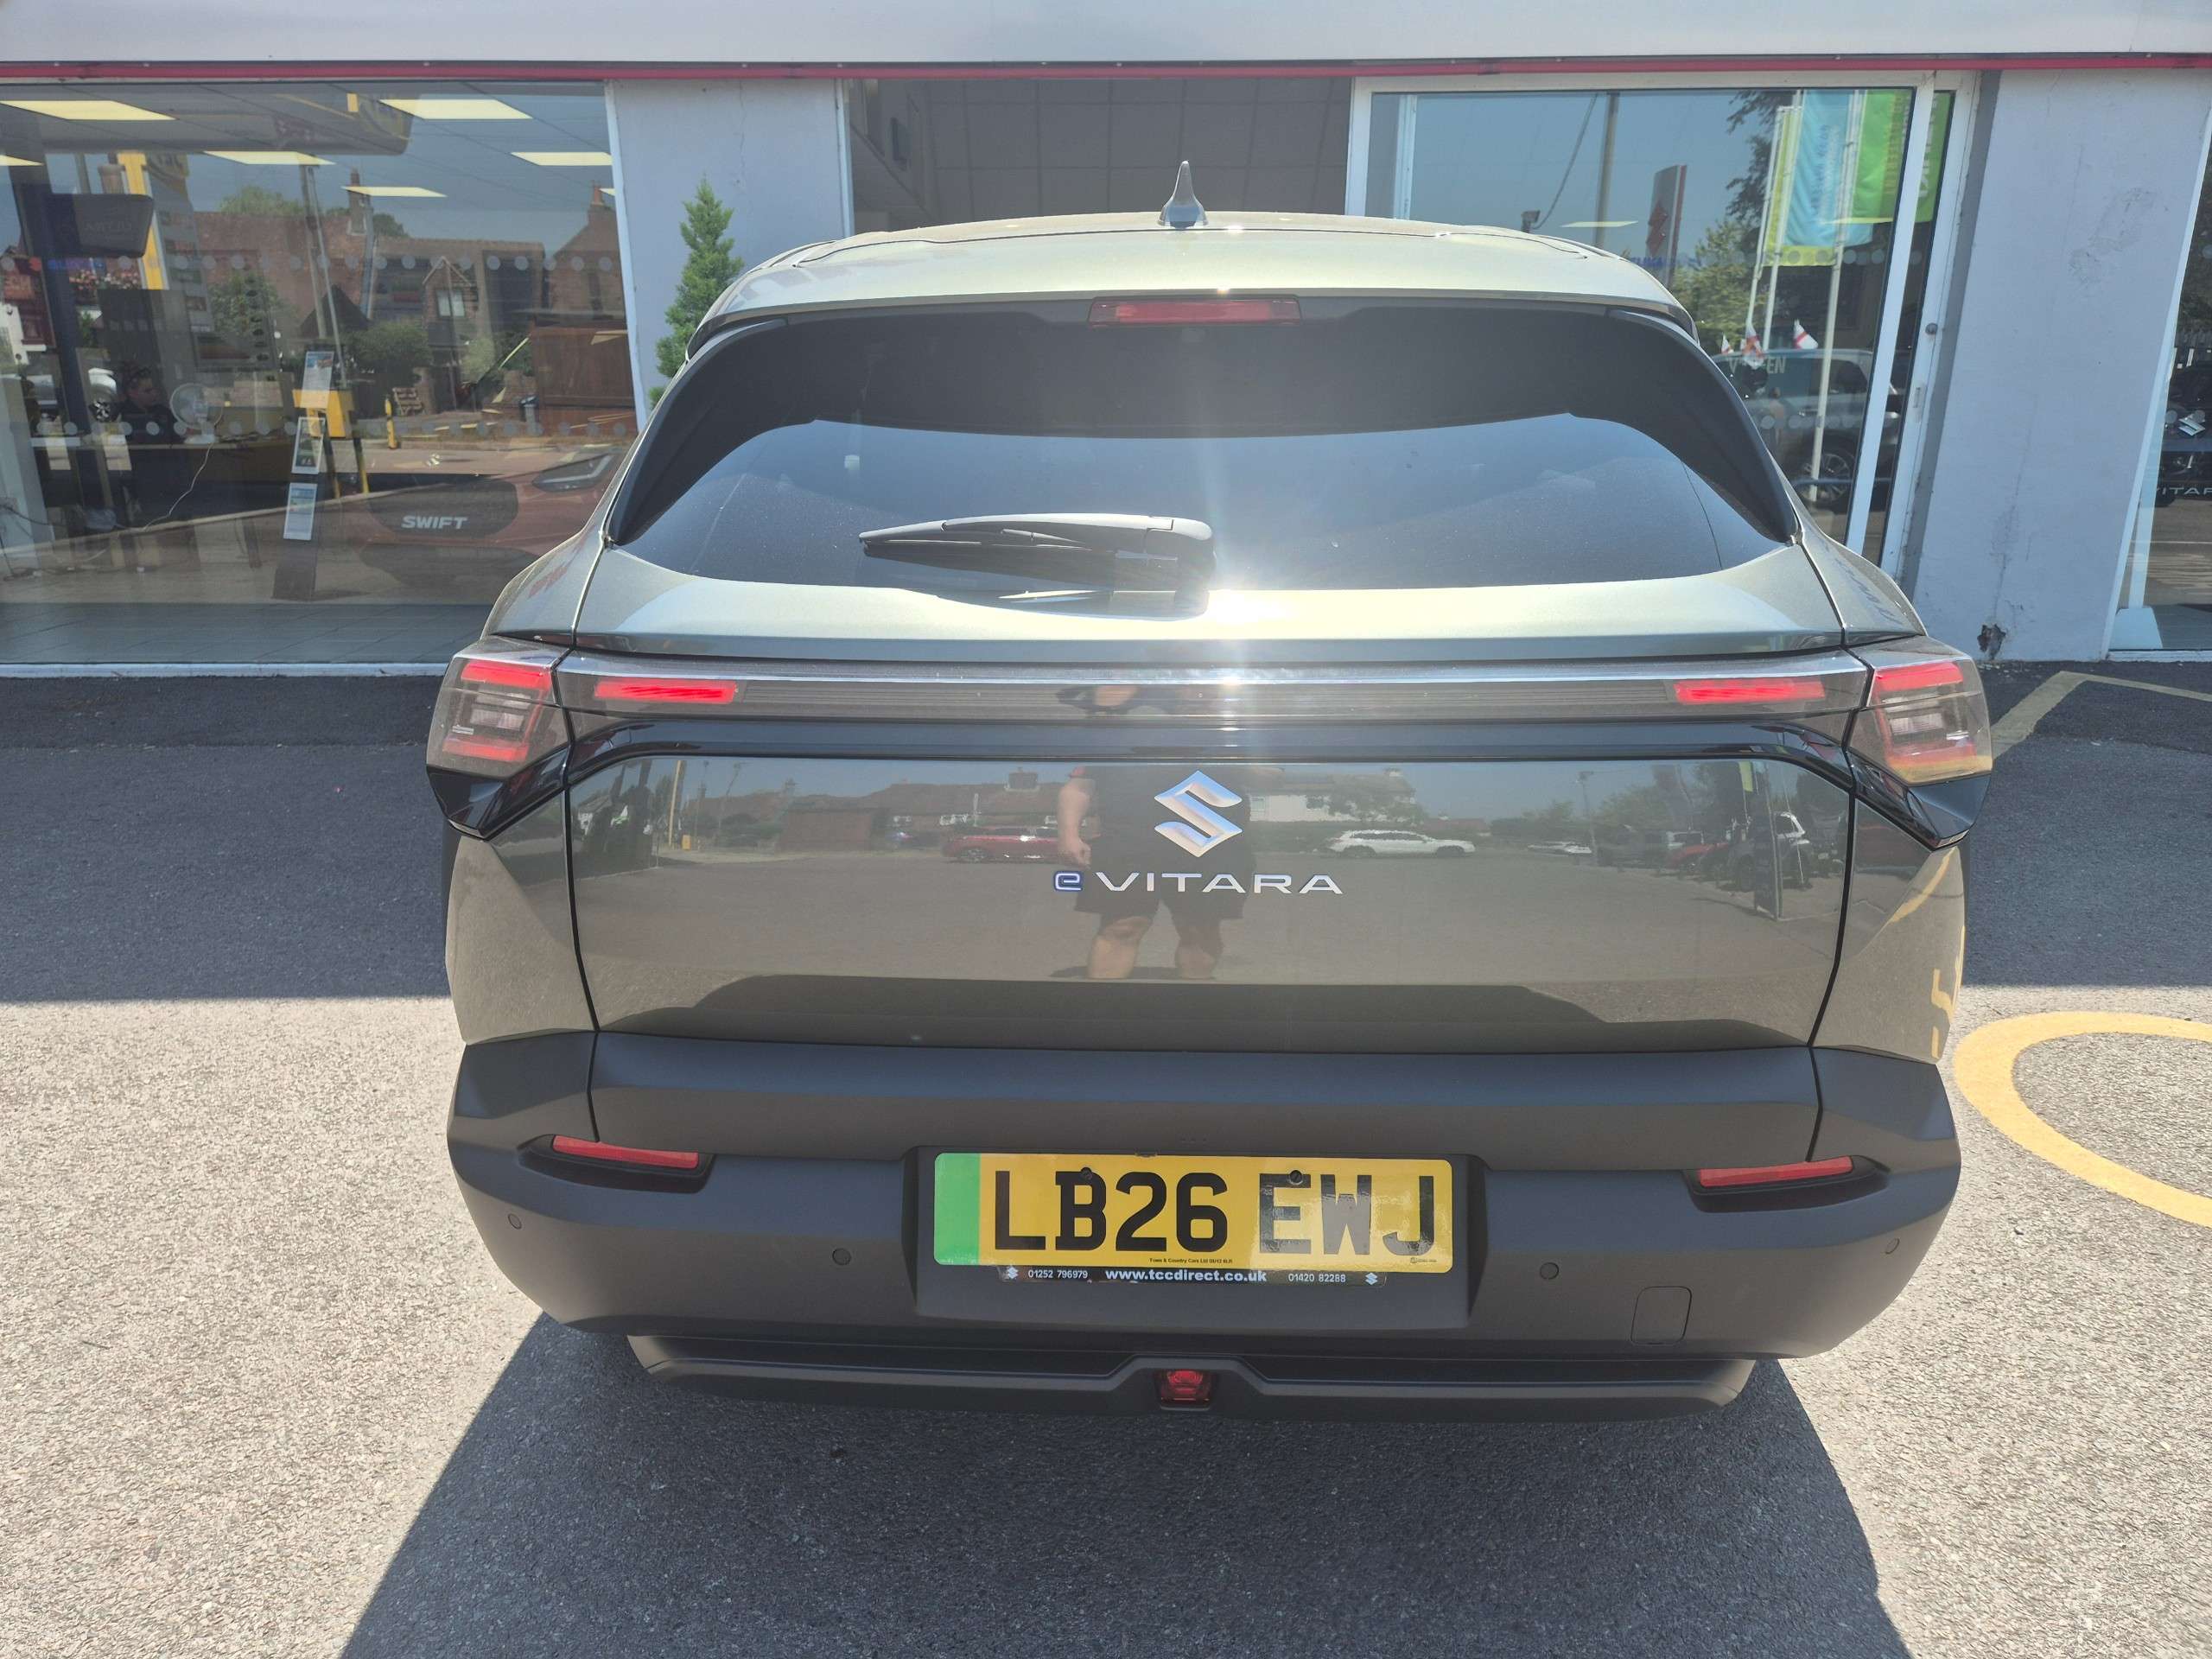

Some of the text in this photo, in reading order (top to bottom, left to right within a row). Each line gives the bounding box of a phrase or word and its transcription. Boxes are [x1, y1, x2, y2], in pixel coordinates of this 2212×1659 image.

[401, 515, 468, 530] SWIFT
[1095, 871, 1344, 894] VITARA
[995, 1170, 1434, 1256] LB26 EWJ
[1027, 1269, 1088, 1280] 01252 796979
[1105, 1268, 1267, 1281] www.tccdirect.co.uk
[1288, 1273, 1346, 1283] 01420 82288
